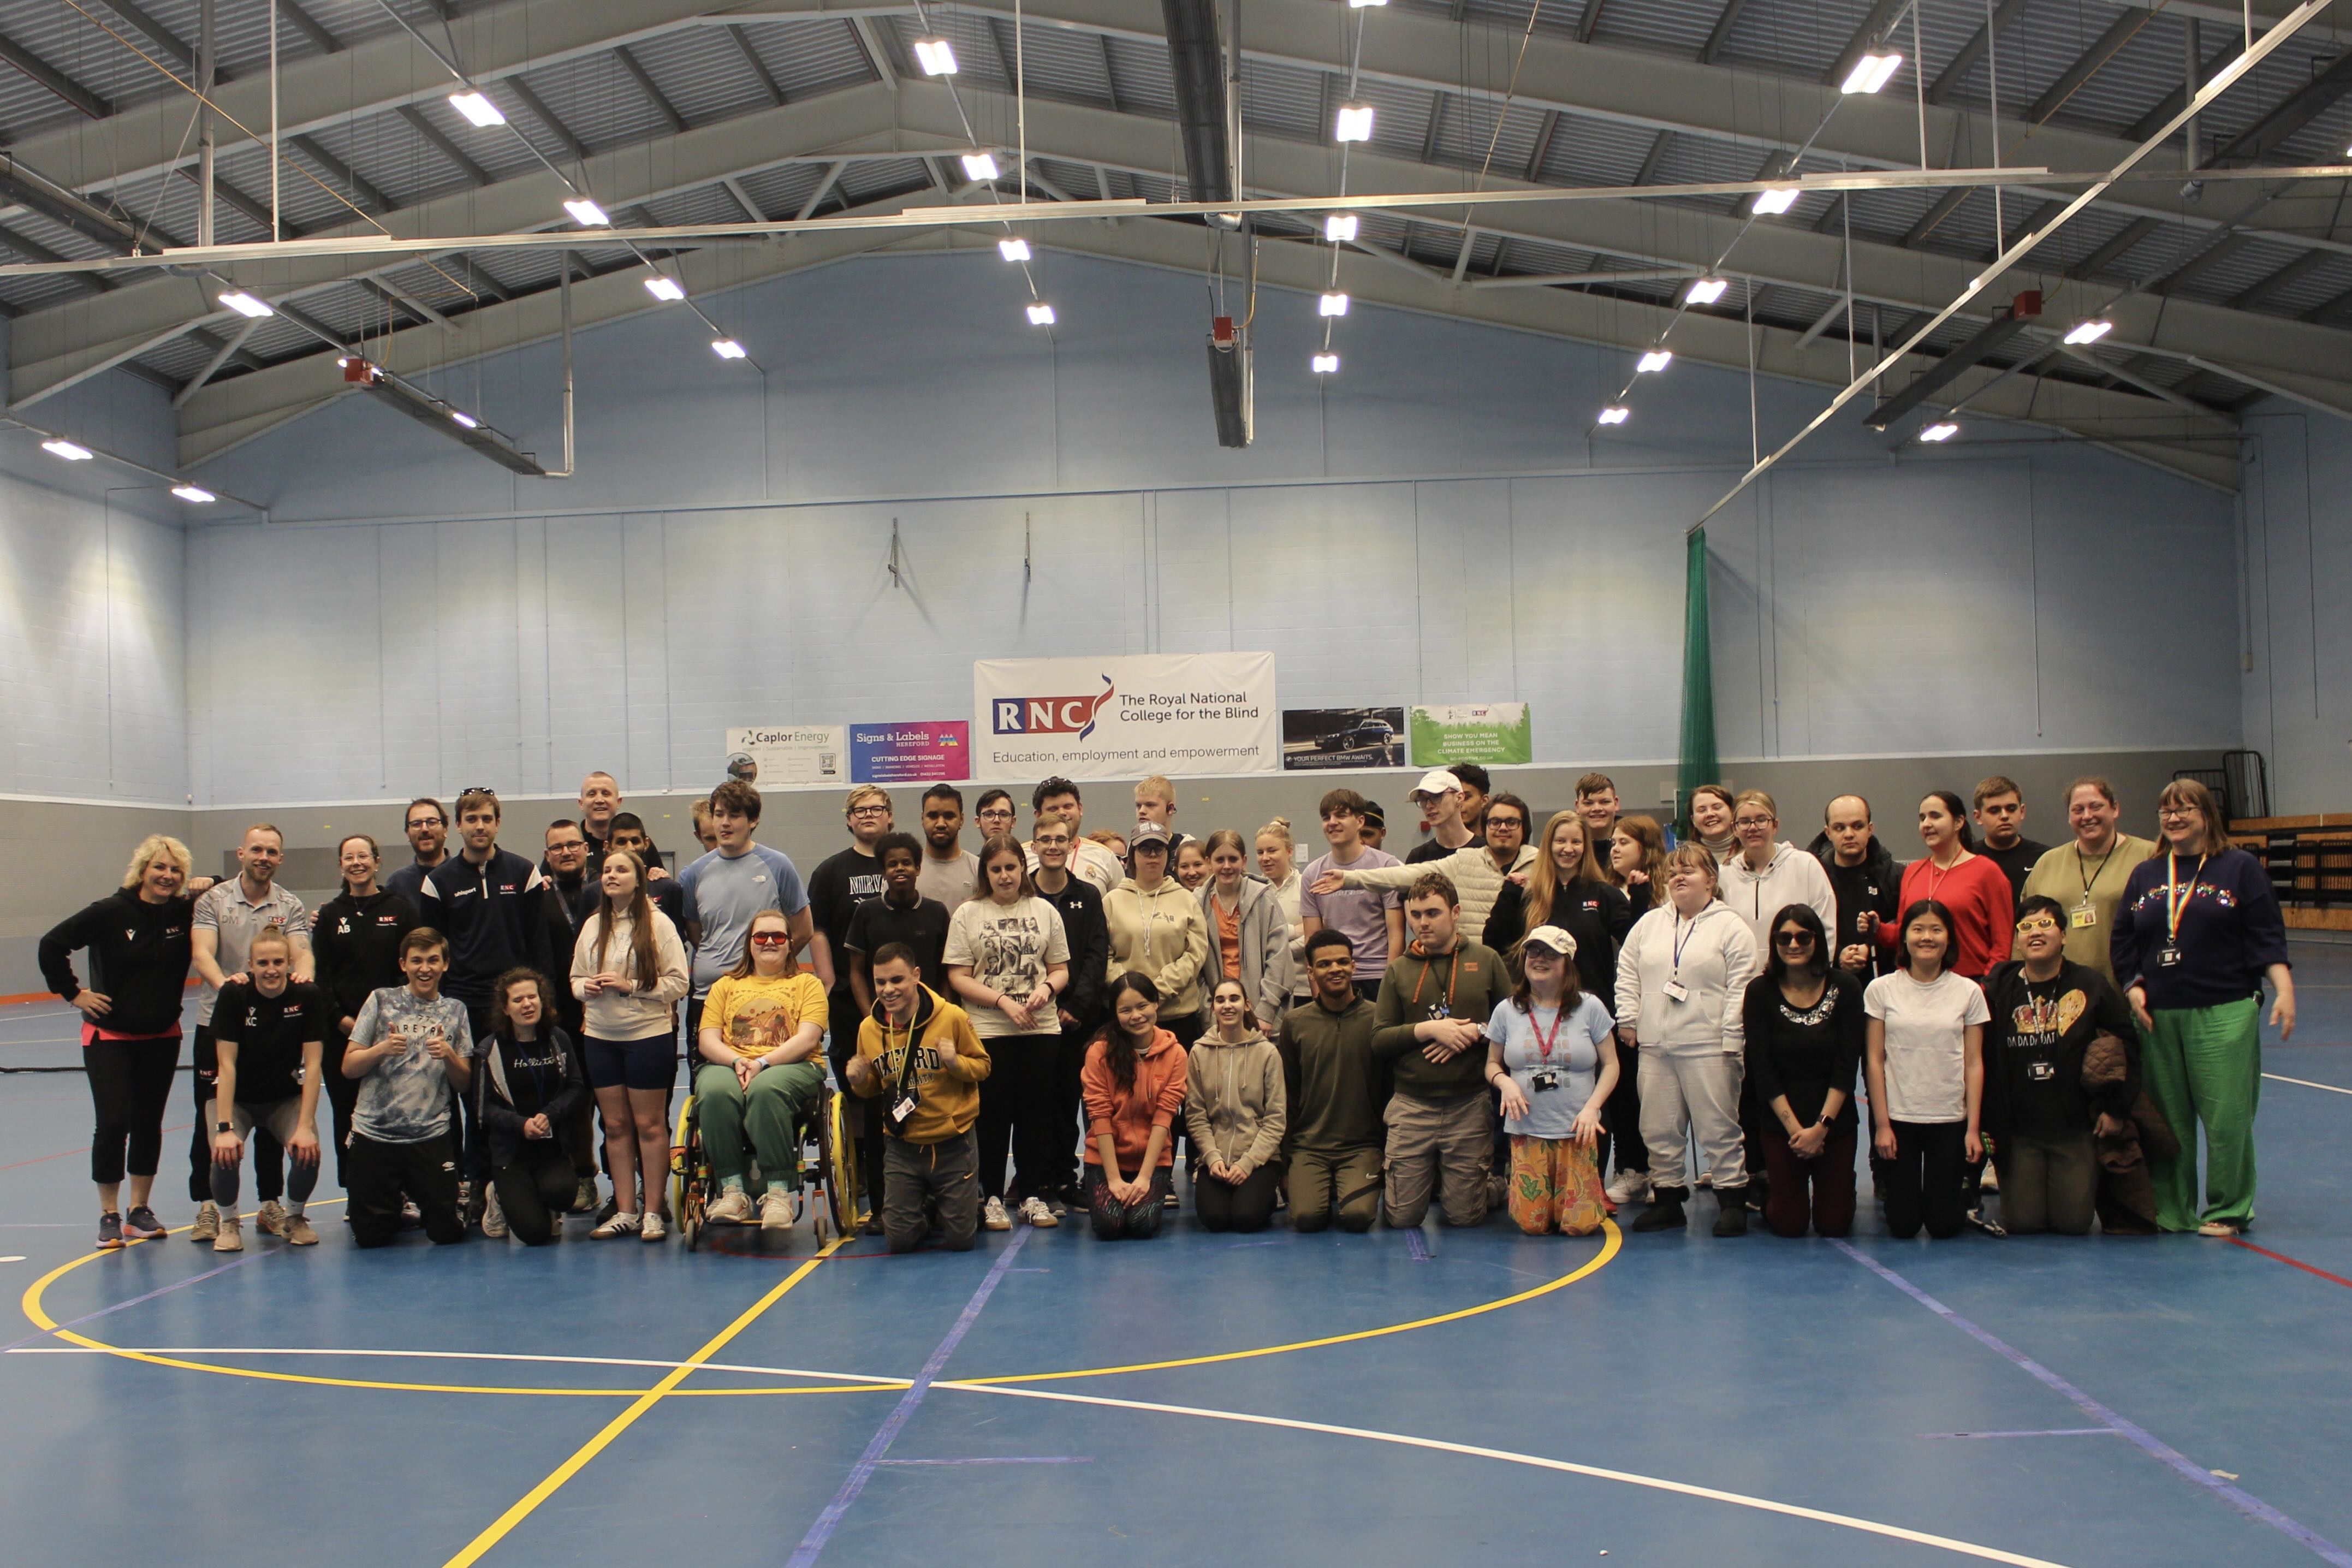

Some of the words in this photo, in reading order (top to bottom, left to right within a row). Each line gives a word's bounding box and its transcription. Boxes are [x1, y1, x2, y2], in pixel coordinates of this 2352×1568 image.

[1119, 694, 1145, 706] The
[1149, 693, 1186, 707] Royal
[1190, 691, 1247, 704] National
[997, 701, 1086, 730] RNC
[1120, 709, 1172, 723] College
[1176, 708, 1195, 720] for
[1199, 708, 1221, 720] the
[1225, 706, 1259, 719] Blind
[756, 732, 792, 744] Caplor
[794, 731, 830, 743] Energy
[857, 733, 885, 744] Signs
[886, 733, 894, 741] &
[895, 730, 929, 741] Labels
[993, 751, 1059, 763] Education,
[1062, 749, 1139, 763] employment
[1143, 747, 1166, 759] and
[1169, 745, 1260, 760] empowerment
[222, 915, 239, 925] DM
[337, 924, 351, 935] AB
[245, 1016, 257, 1026] KC
[2007, 1036, 2017, 1048] DA
[2017, 1035, 2029, 1047] DA
